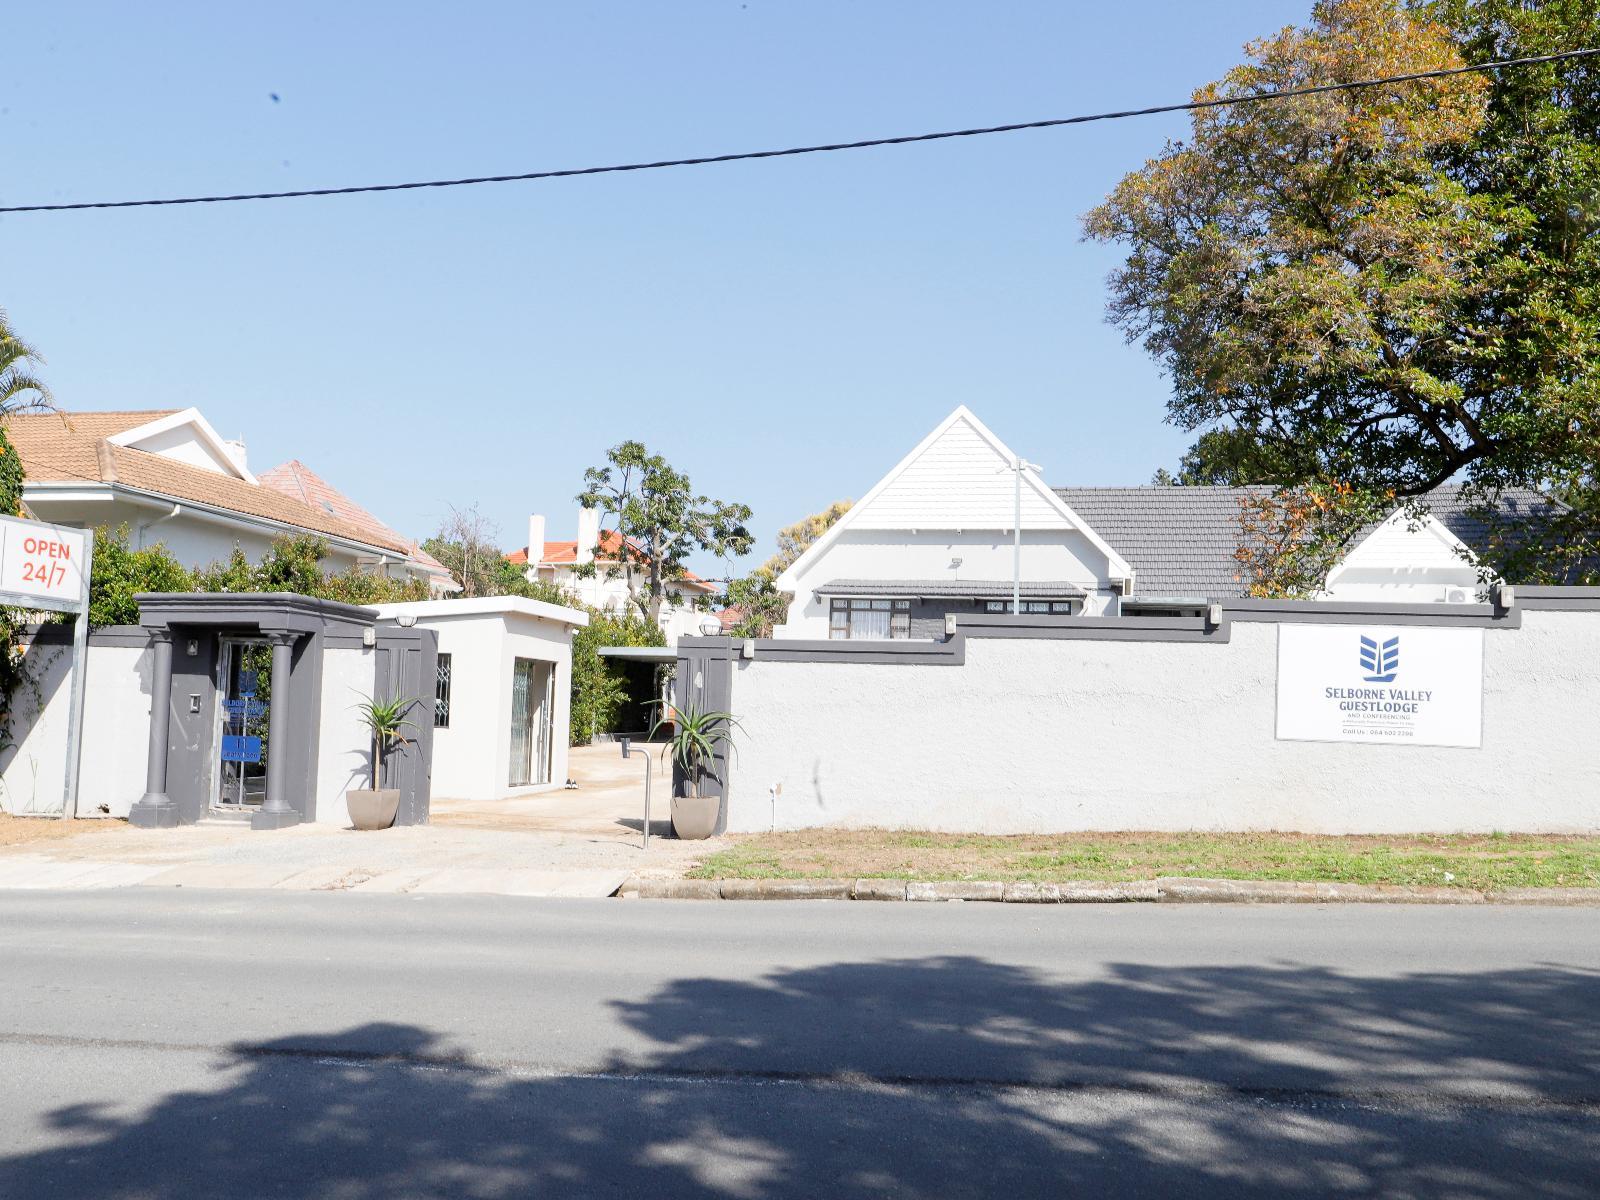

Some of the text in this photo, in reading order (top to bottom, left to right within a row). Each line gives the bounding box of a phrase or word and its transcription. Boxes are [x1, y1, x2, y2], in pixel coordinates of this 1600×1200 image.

[23, 537, 71, 560] OPEN
[22, 561, 66, 588] 24/7
[1325, 687, 1433, 702] SELBORNE VALLEY
[1339, 701, 1419, 714] GUESTLODGE
[1362, 713, 1411, 721] CONFERENCING
